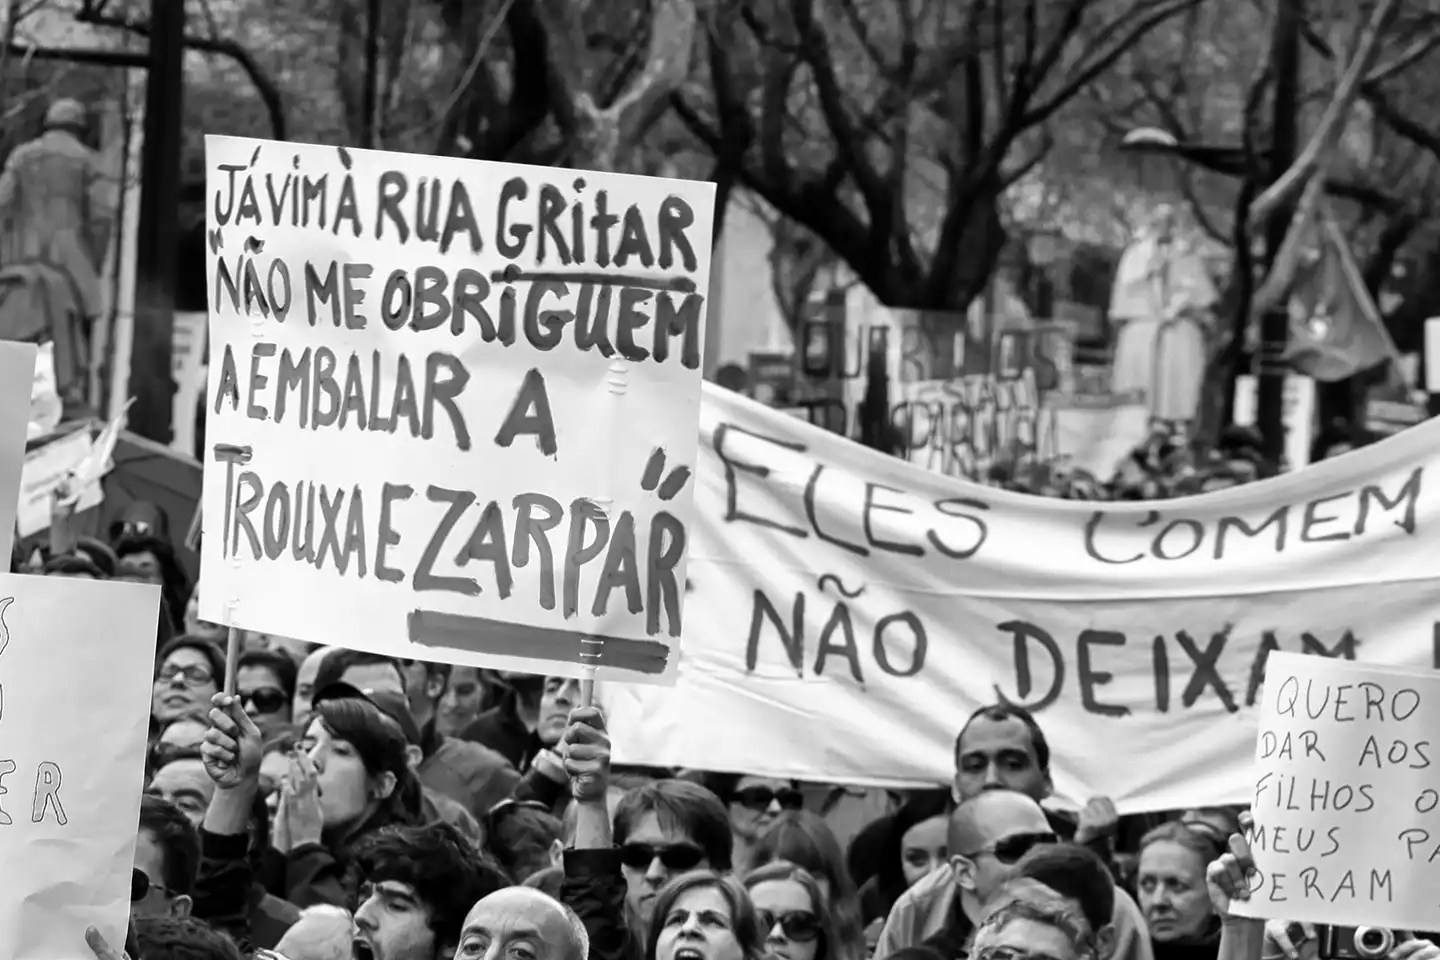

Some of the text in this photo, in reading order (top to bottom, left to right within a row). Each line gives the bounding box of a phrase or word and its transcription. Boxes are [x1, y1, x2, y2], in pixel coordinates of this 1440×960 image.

[215, 145, 262, 227] JÁ
[332, 146, 362, 238] À
[375, 171, 483, 254] RUA
[305, 260, 374, 330] ME
[214, 343, 240, 414] A
[246, 342, 470, 451] EMBALAR
[495, 368, 558, 460] A
[213, 443, 367, 578] TROUXA
[374, 481, 415, 582] E
[712, 423, 990, 559] ELES
[1085, 467, 1423, 563] COMEM
[746, 574, 928, 684] NÃO
[1261, 730, 1430, 768] DAR AOS
[1277, 676, 1420, 721] QUERO
[1248, 825, 1340, 857] MEUS
